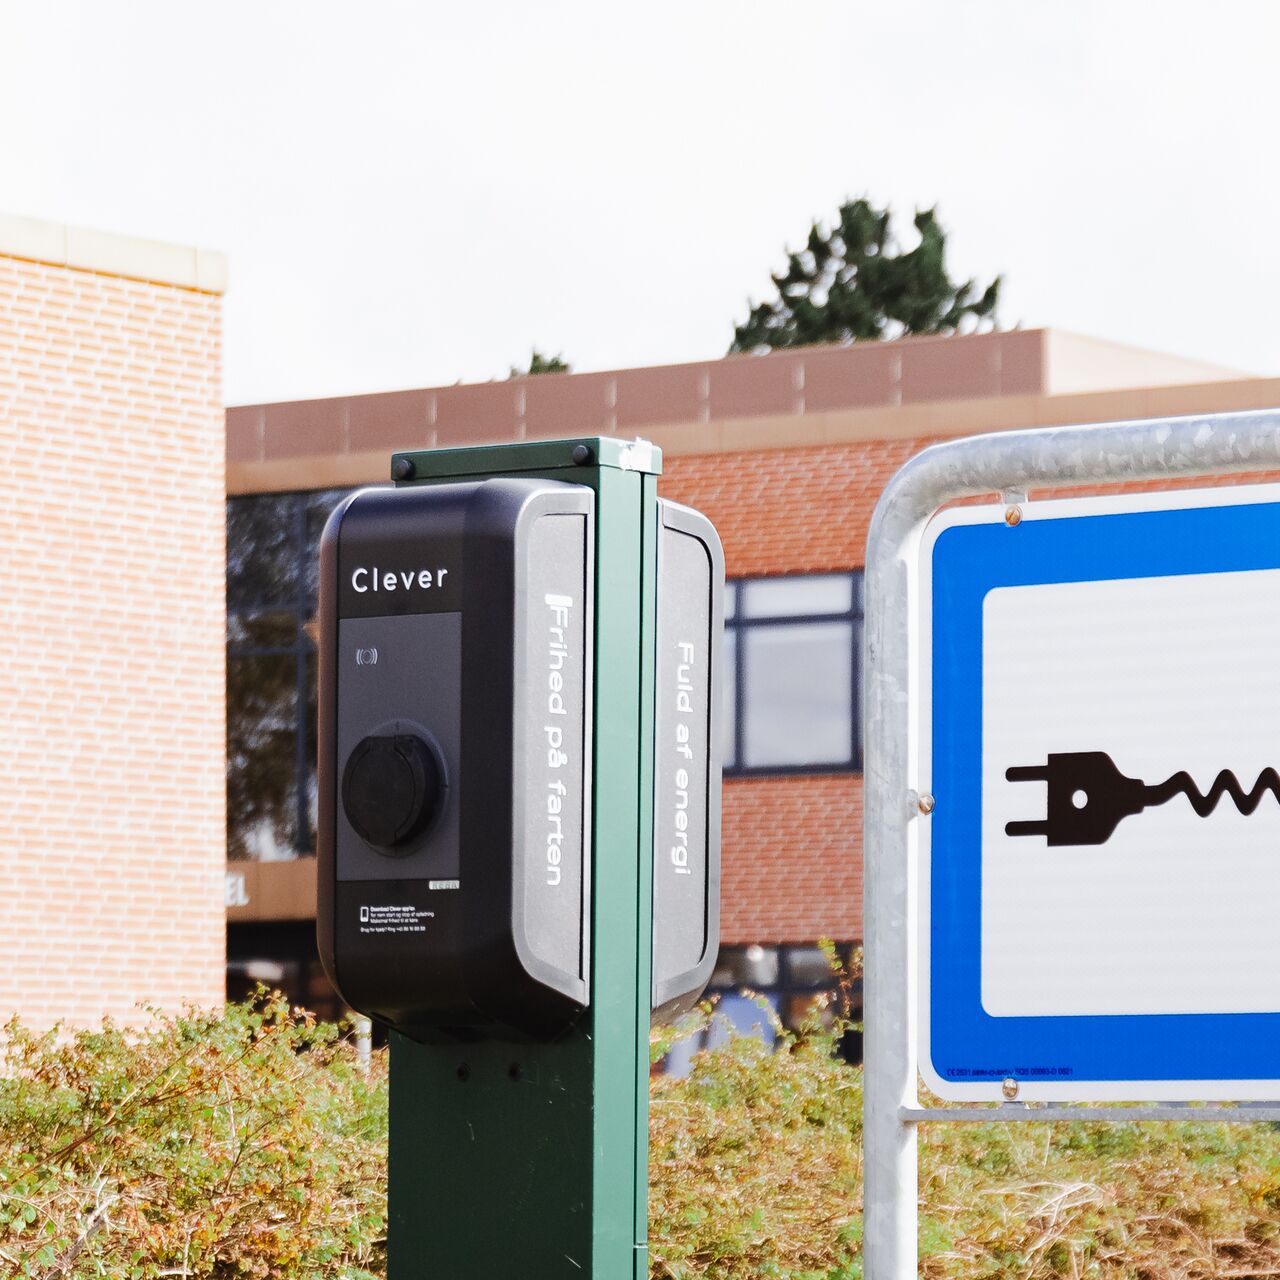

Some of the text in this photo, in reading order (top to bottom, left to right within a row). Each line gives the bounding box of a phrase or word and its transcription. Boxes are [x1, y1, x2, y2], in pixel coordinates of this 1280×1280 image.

[351, 567, 448, 593] Clever
[544, 606, 570, 886] Frihed på farten
[670, 641, 695, 875] Fuld af energi
